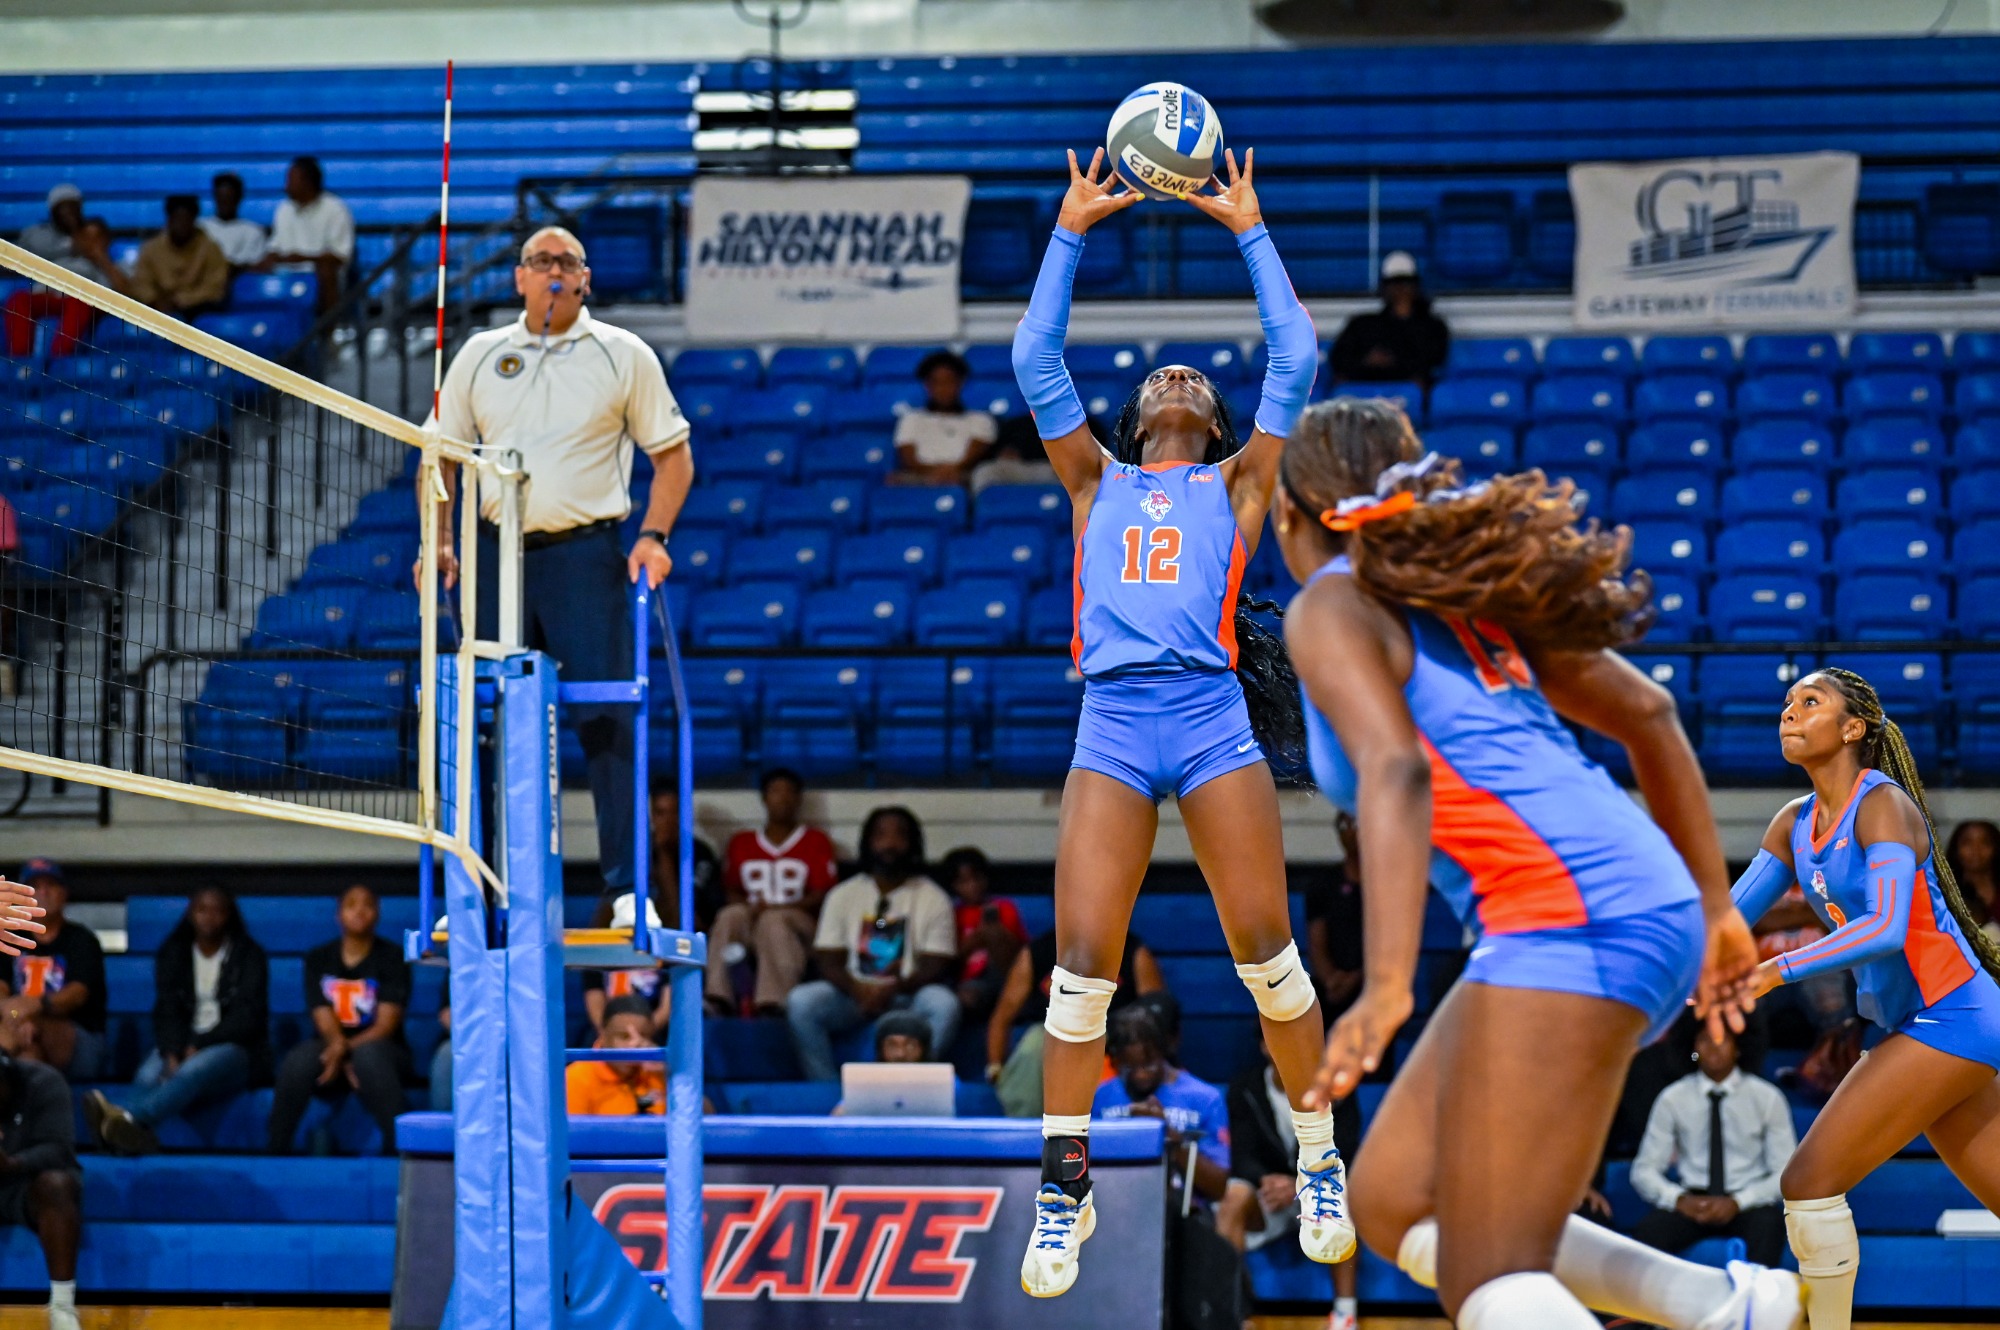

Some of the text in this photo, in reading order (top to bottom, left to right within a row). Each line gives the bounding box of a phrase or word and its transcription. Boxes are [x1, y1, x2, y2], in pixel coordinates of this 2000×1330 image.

[718, 210, 945, 238] SAVANNAH
[1636, 169, 1782, 238] GT
[700, 237, 959, 265] HILTON HEAD
[1588, 293, 1708, 319] GATEWAY
[1121, 526, 1182, 584] 12
[592, 1183, 1003, 1302] STATE
